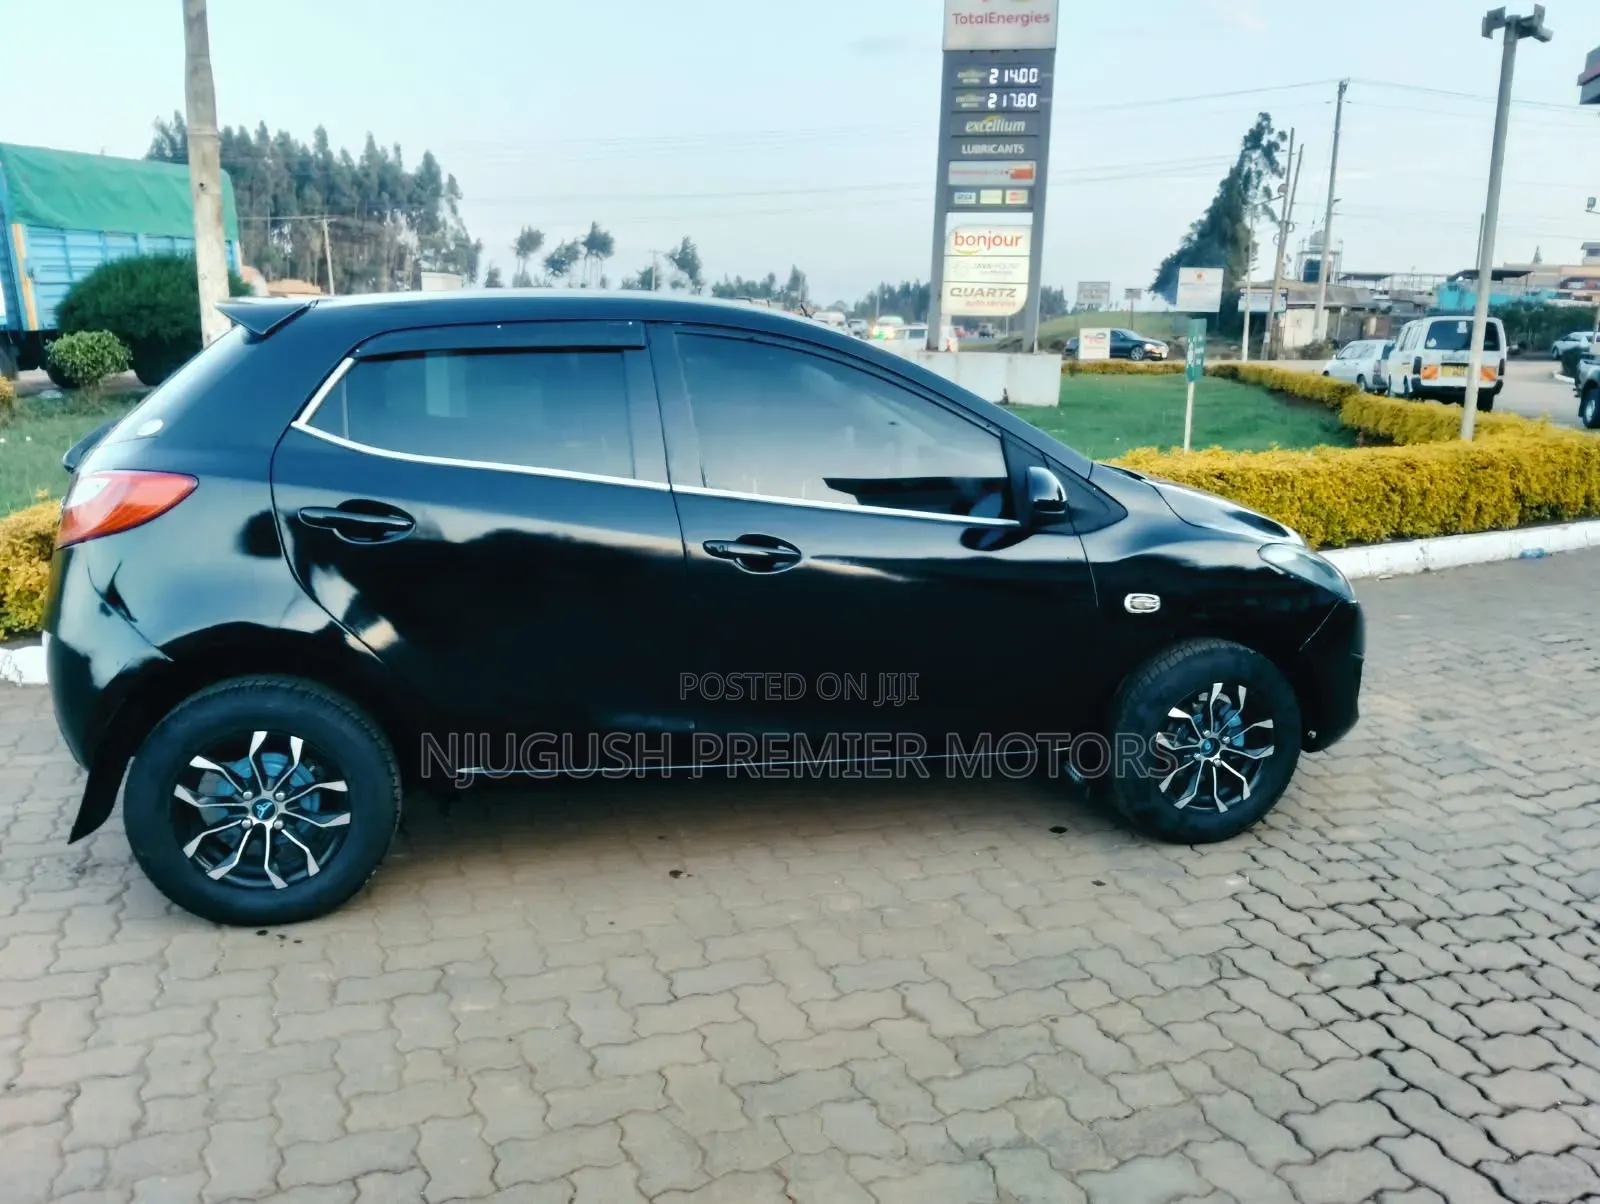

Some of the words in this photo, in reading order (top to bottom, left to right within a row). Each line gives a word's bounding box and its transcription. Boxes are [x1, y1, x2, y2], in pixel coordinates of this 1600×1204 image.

[952, 11, 1051, 27] TotalEnergies
[965, 118, 1026, 133] excellium
[961, 144, 1025, 155] LUBRICANTS
[954, 230, 1024, 251] bonjour
[950, 287, 1017, 298] QUARTZ
